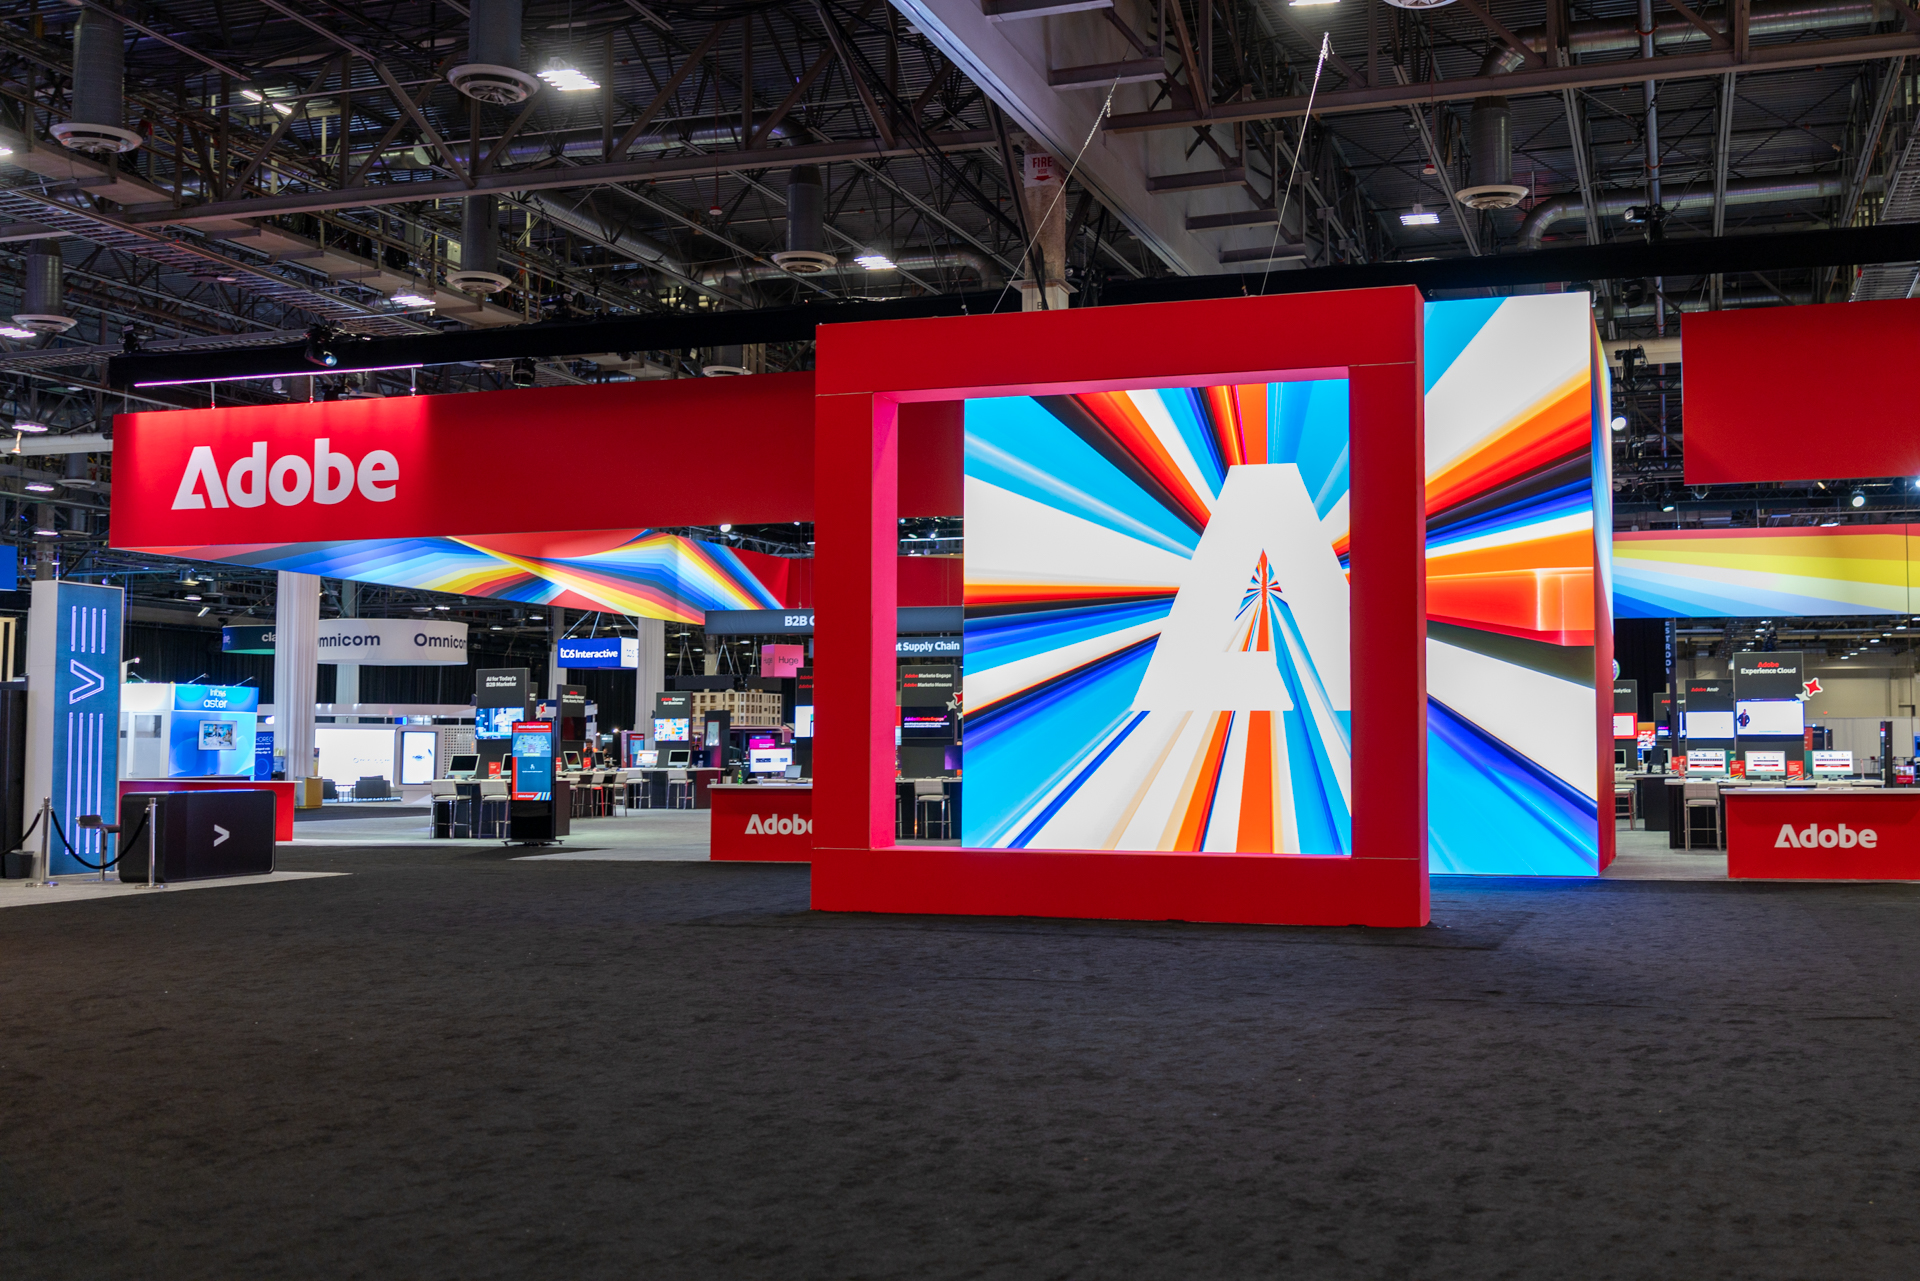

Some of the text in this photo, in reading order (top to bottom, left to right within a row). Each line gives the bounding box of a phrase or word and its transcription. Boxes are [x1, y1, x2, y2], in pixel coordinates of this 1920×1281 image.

[1032, 157, 1052, 168] FIRE
[171, 438, 400, 510] Adobe
[784, 615, 808, 627] B2B
[317, 633, 380, 647] mnicom
[902, 641, 934, 653] Supply
[934, 641, 960, 651] Chain
[575, 648, 619, 659] Interactive
[778, 656, 799, 666] Huge
[1740, 668, 1777, 676] Experience
[203, 698, 228, 709] aster
[1774, 823, 1878, 849] Adobe
